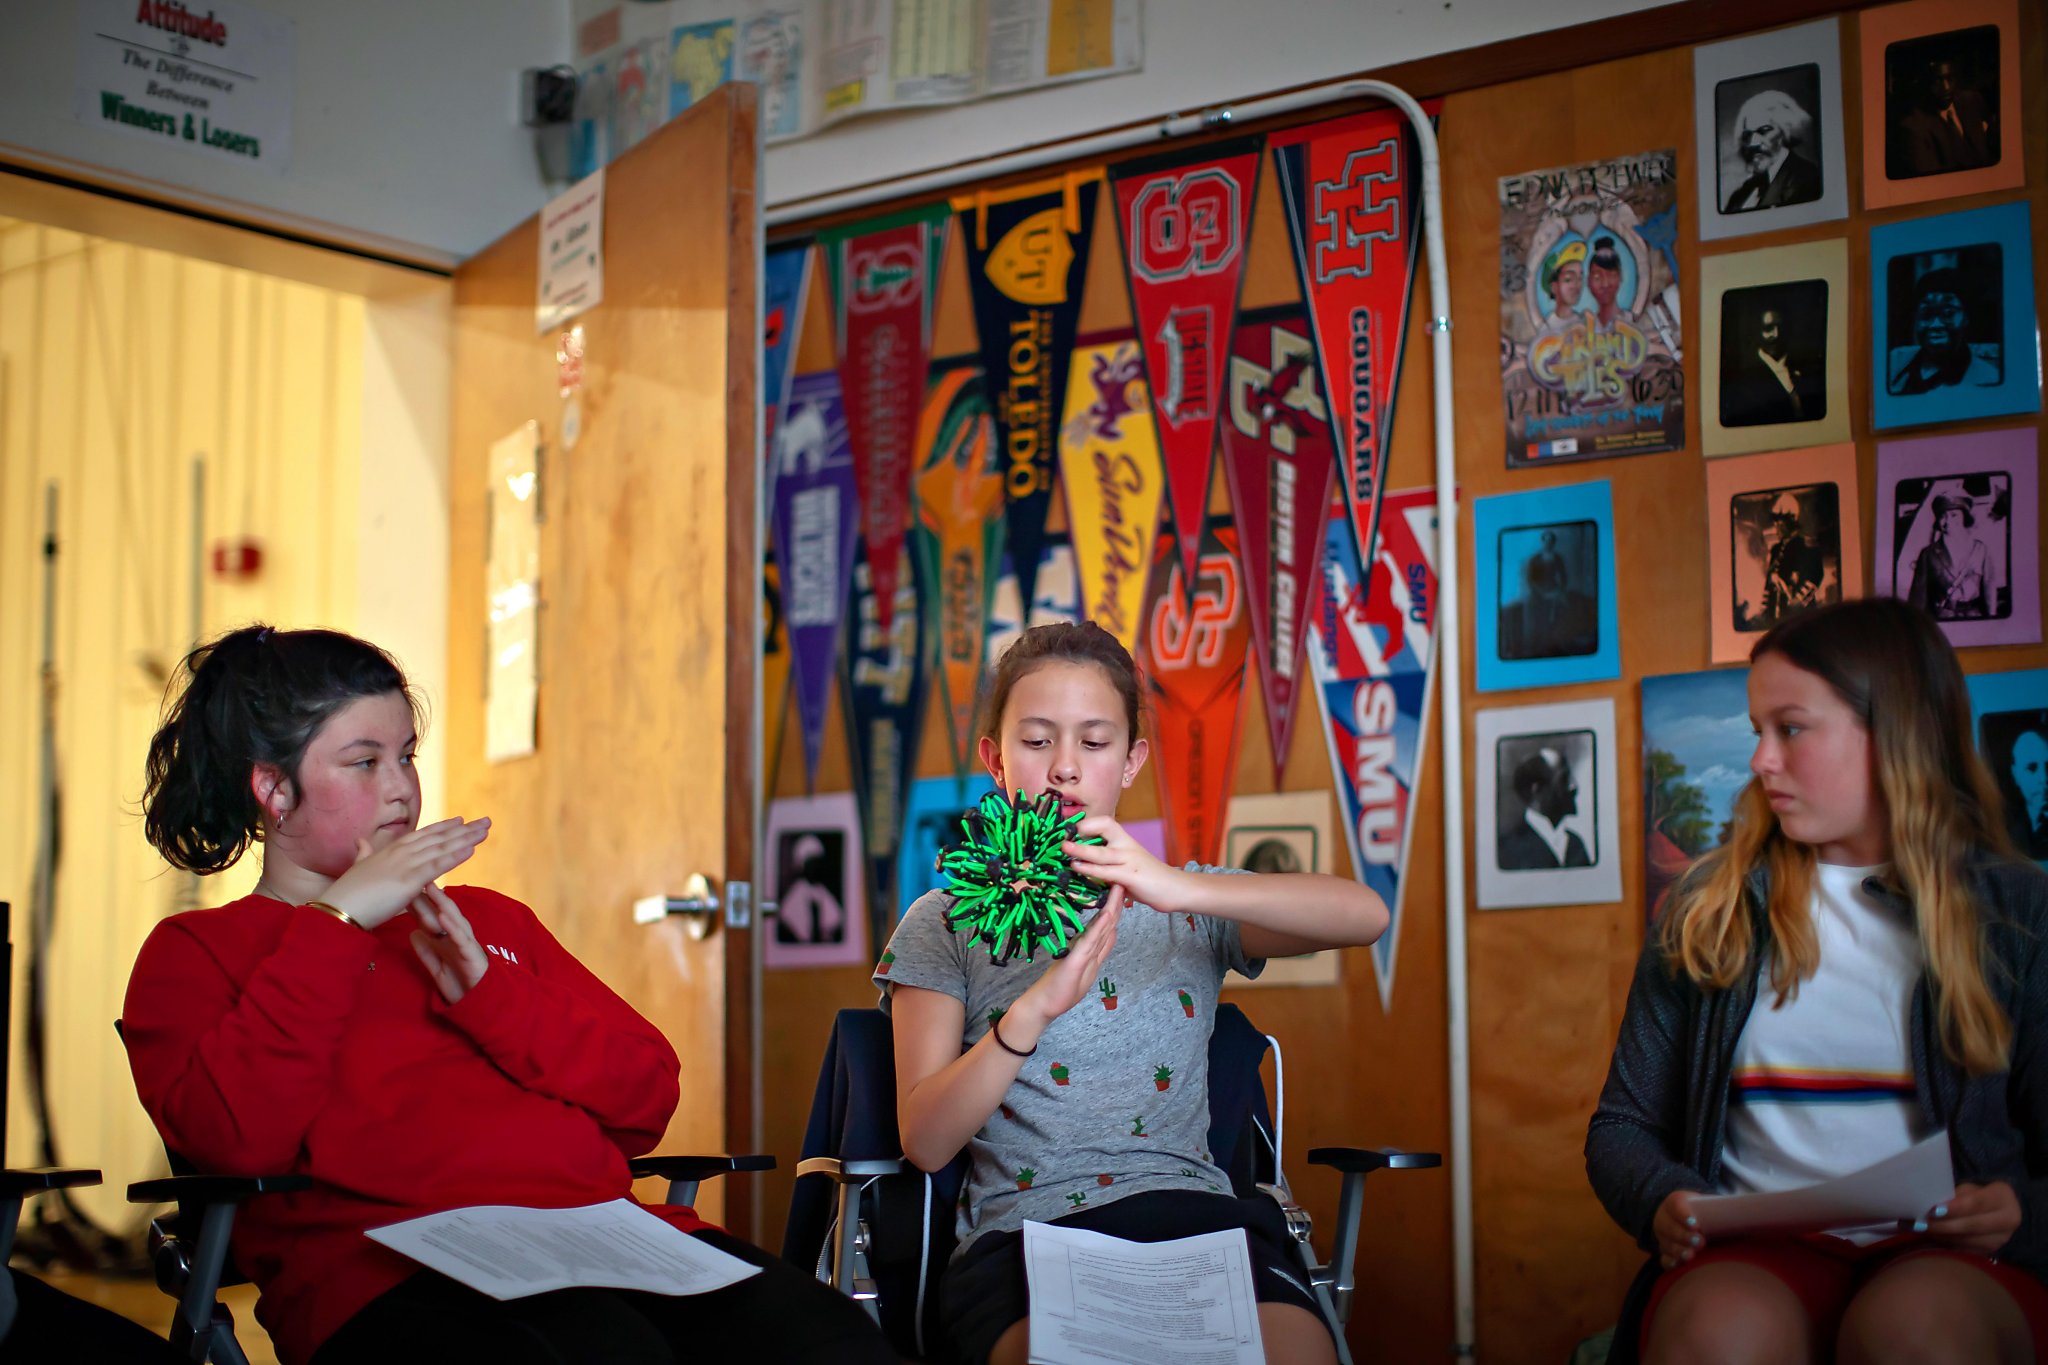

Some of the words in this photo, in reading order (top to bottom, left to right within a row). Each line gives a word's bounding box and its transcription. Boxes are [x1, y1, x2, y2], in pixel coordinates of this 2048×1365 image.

[138, 0, 227, 46] Attitude
[122, 48, 150, 69] The
[155, 58, 234, 94] Difference
[146, 81, 209, 109] Between
[100, 89, 177, 136] Winners
[181, 111, 197, 141] &
[201, 116, 261, 159] Losers
[1006, 309, 1041, 500] TOLEDO
[1350, 307, 1374, 504] COUGARS
[1094, 450, 1144, 525] Sun
[1277, 458, 1297, 568] BOSTON
[1275, 570, 1297, 681] COLLEGE
[1408, 563, 1428, 625] SMU
[1352, 680, 1399, 869] SMU
